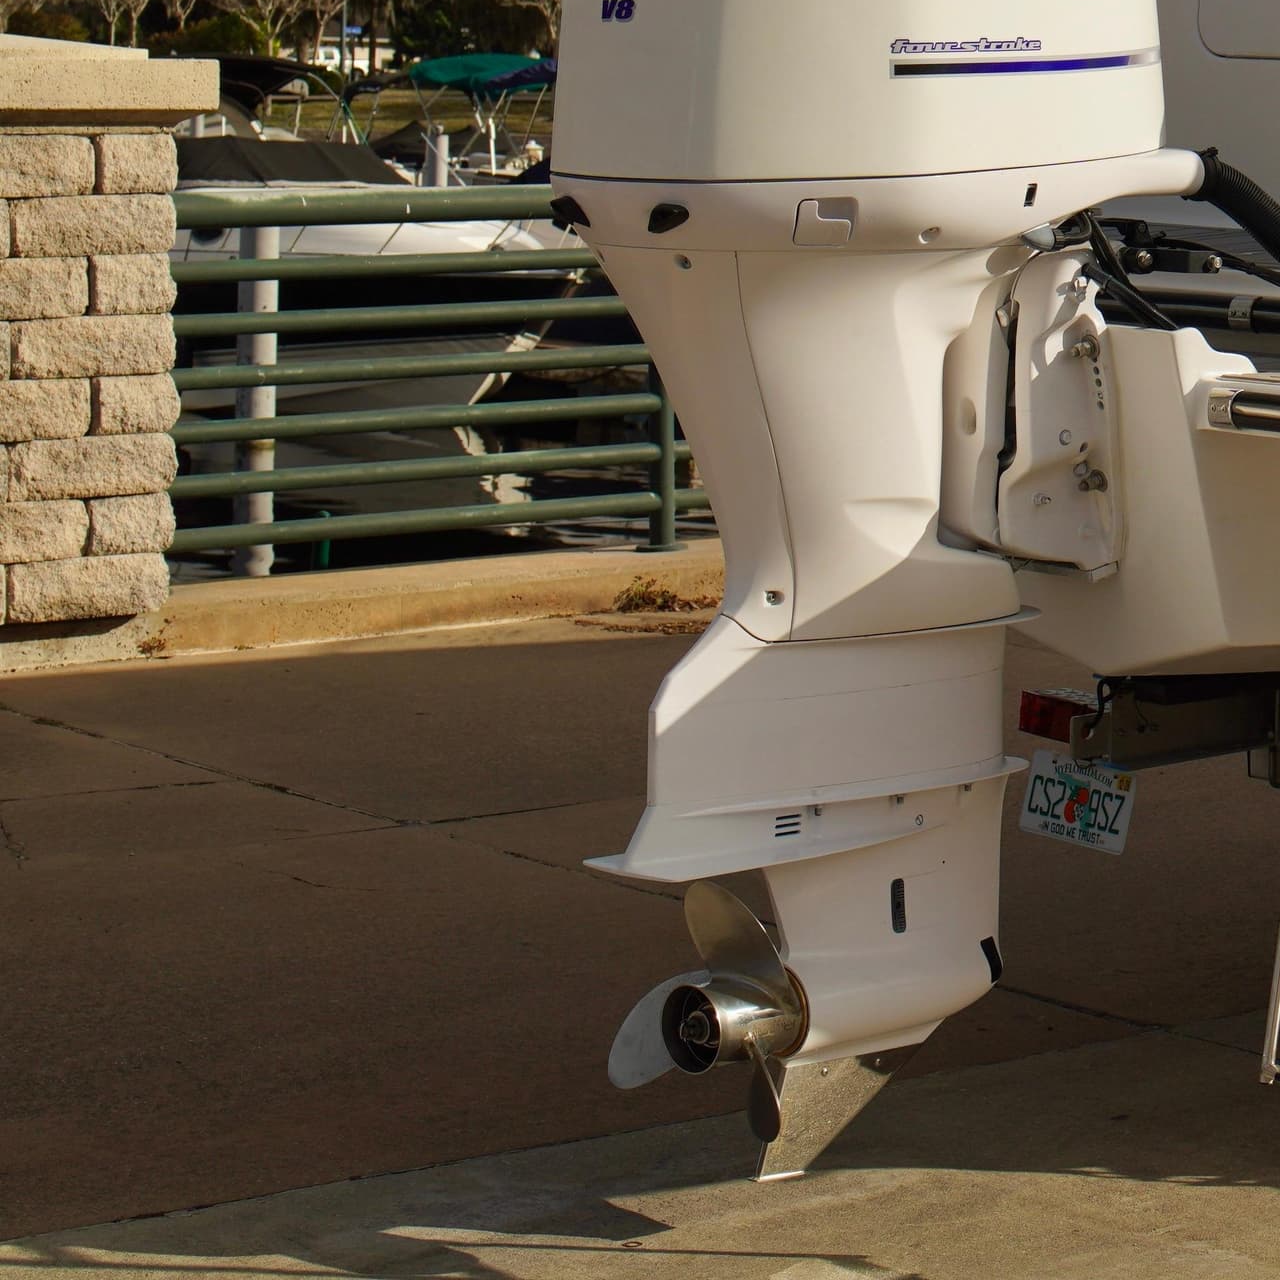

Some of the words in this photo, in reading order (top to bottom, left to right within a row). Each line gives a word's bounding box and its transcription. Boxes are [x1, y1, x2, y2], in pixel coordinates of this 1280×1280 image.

[601, 0, 636, 23] V8
[1051, 824, 1065, 836] GOD
[1066, 827, 1076, 839] WE
[1077, 829, 1101, 845] TRUST
